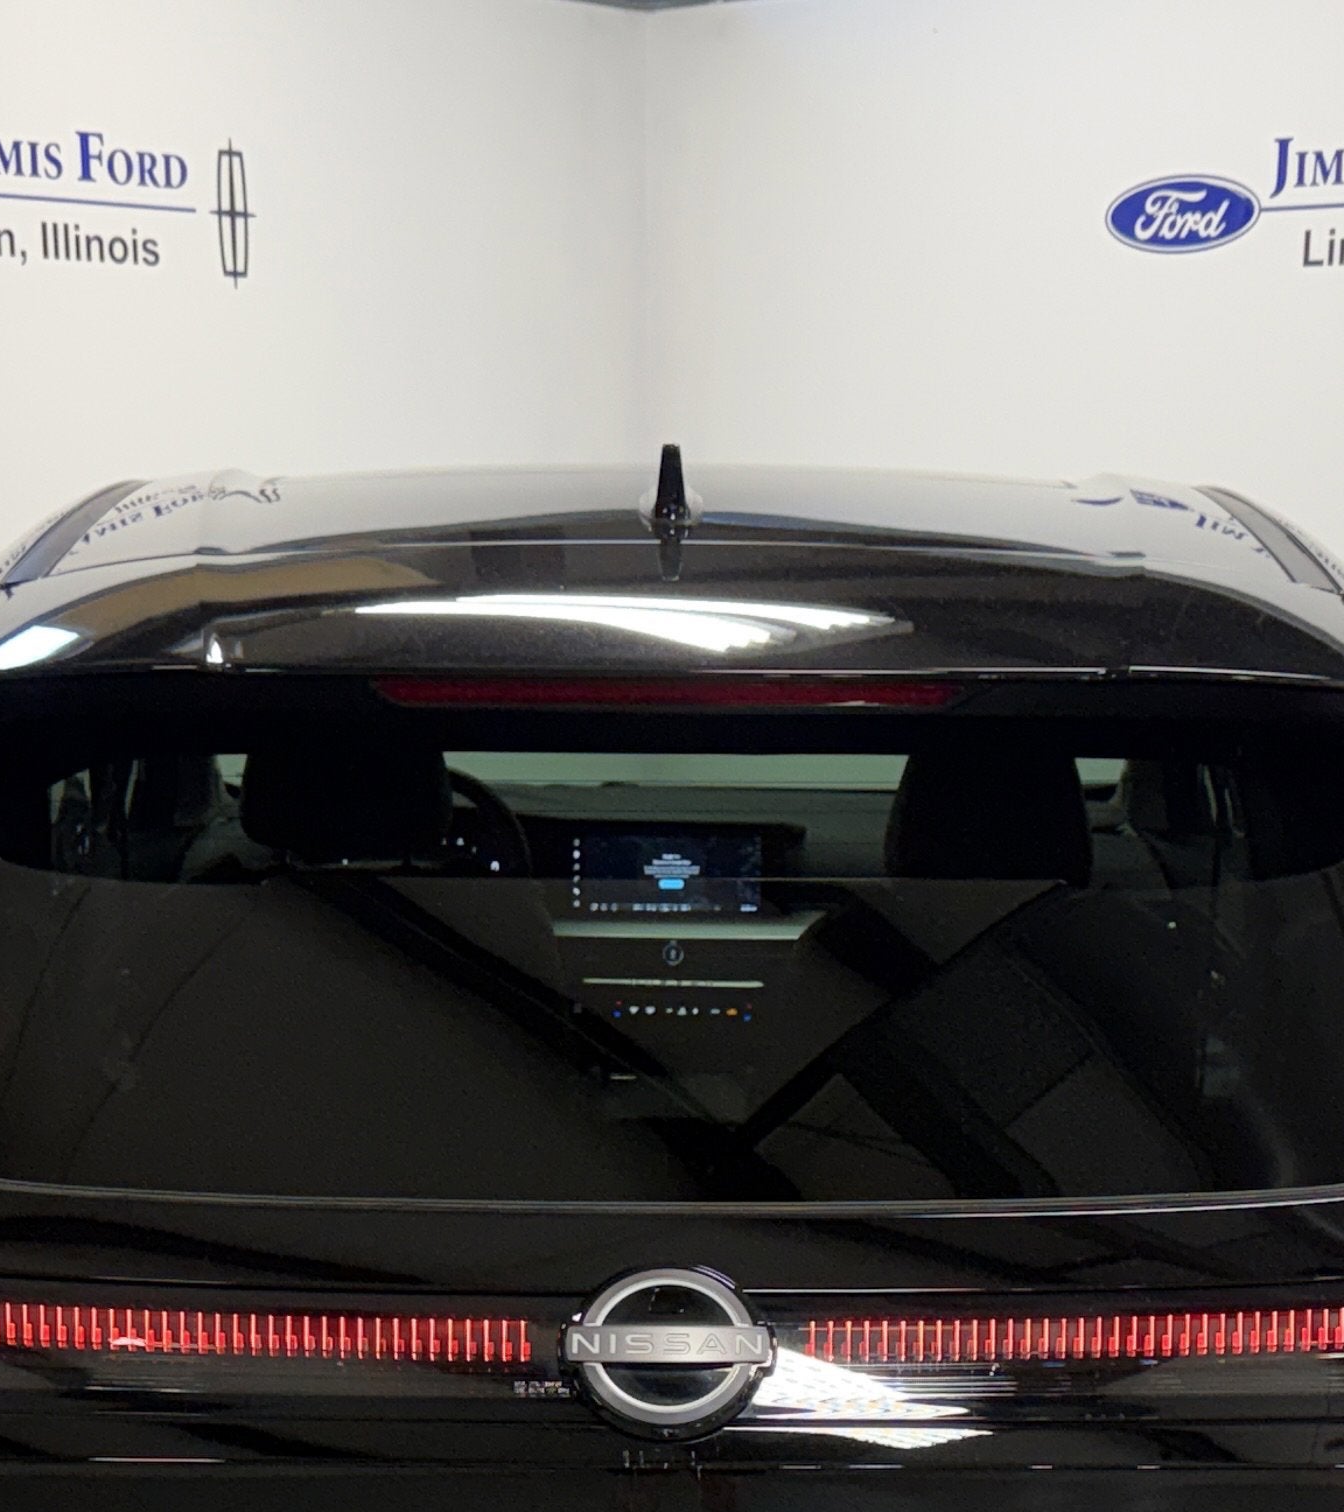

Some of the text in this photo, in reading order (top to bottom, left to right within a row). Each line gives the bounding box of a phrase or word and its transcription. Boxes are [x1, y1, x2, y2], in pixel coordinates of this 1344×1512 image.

[75, 130, 188, 189] FORD
[1133, 189, 1228, 240] Ford
[41, 221, 160, 266] Illinois
[571, 1332, 763, 1356] NISSAN
